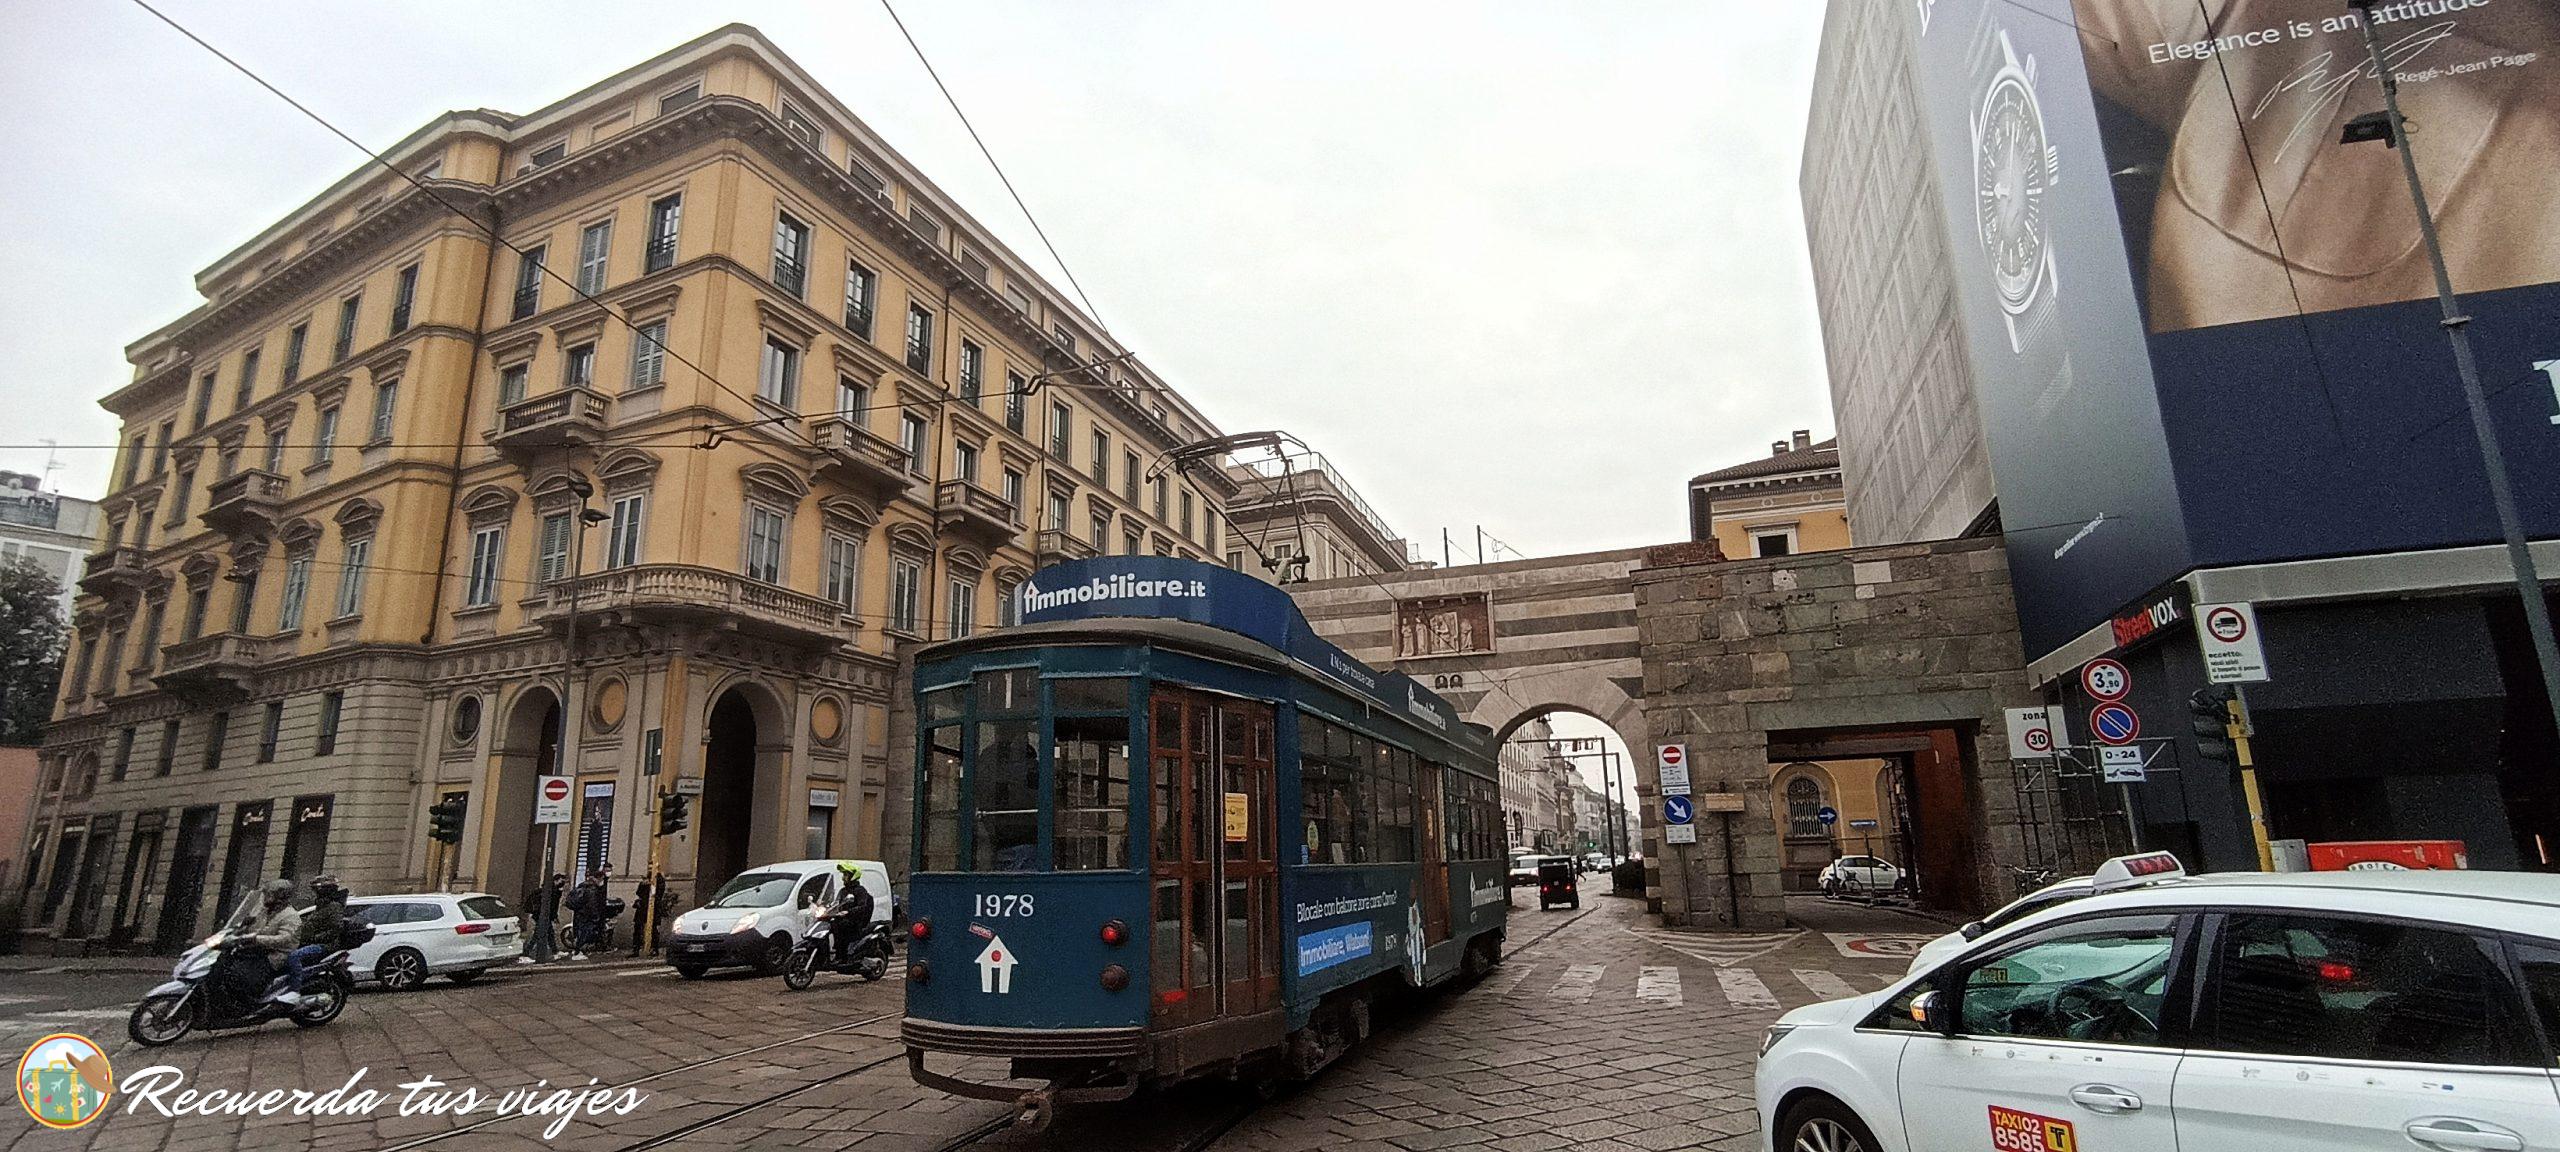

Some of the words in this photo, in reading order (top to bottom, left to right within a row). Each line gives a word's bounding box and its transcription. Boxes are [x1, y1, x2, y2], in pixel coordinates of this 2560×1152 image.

[2147, 27, 2281, 64] Elegance
[2286, 20, 2314, 39] is
[2321, 14, 2359, 33] an
[2490, 52, 2537, 68] Page
[2030, 734, 2047, 745] 30
[2125, 856, 2177, 875] TAXI
[974, 894, 1034, 917] 1978
[1994, 1126, 2045, 1152] 8585
[2050, 1126, 2066, 1148] T
